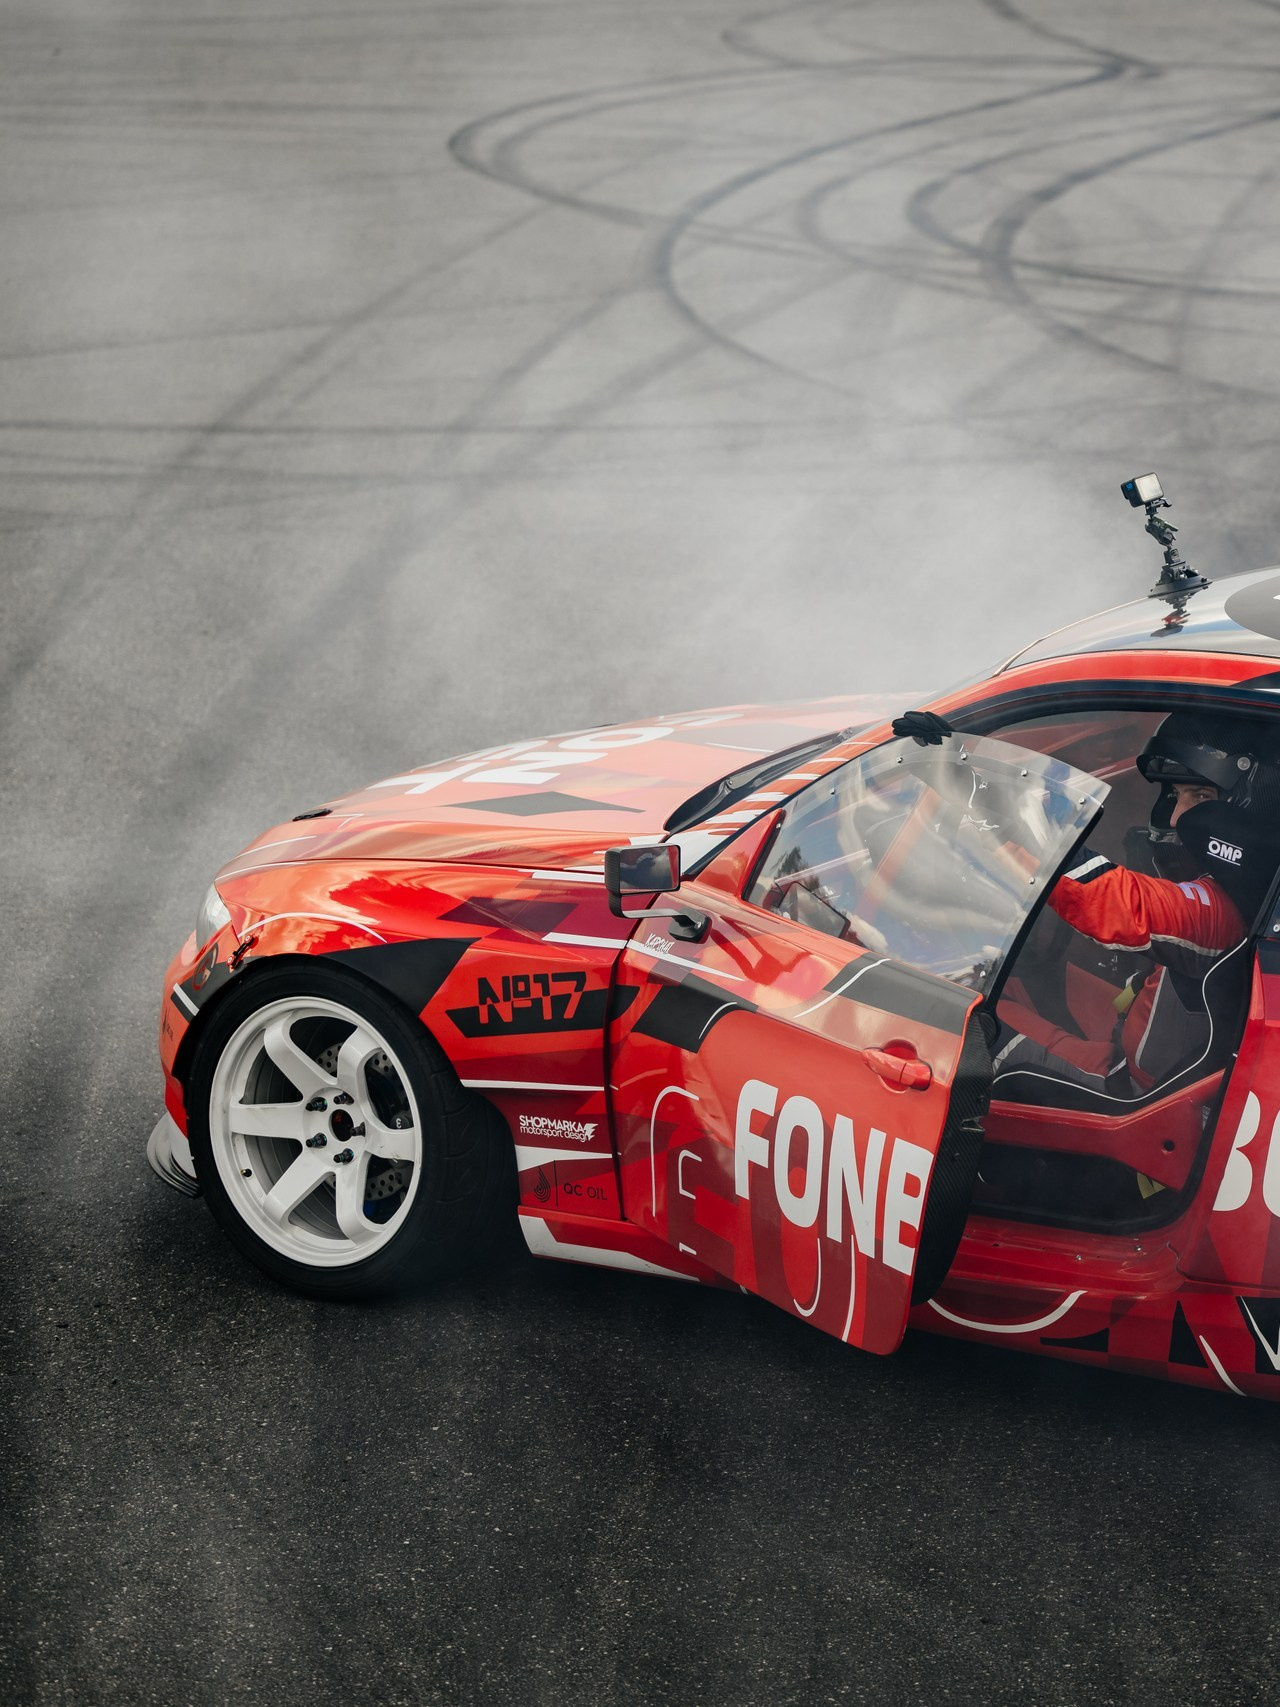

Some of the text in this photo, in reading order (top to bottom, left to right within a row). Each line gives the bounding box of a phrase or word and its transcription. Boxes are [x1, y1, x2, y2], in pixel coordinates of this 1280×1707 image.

[1208, 840, 1243, 862] OMP
[519, 1114, 585, 1133] SHOPMARKA
[520, 1126, 564, 1138] motorsport
[563, 1182, 608, 1201] QC OIL
